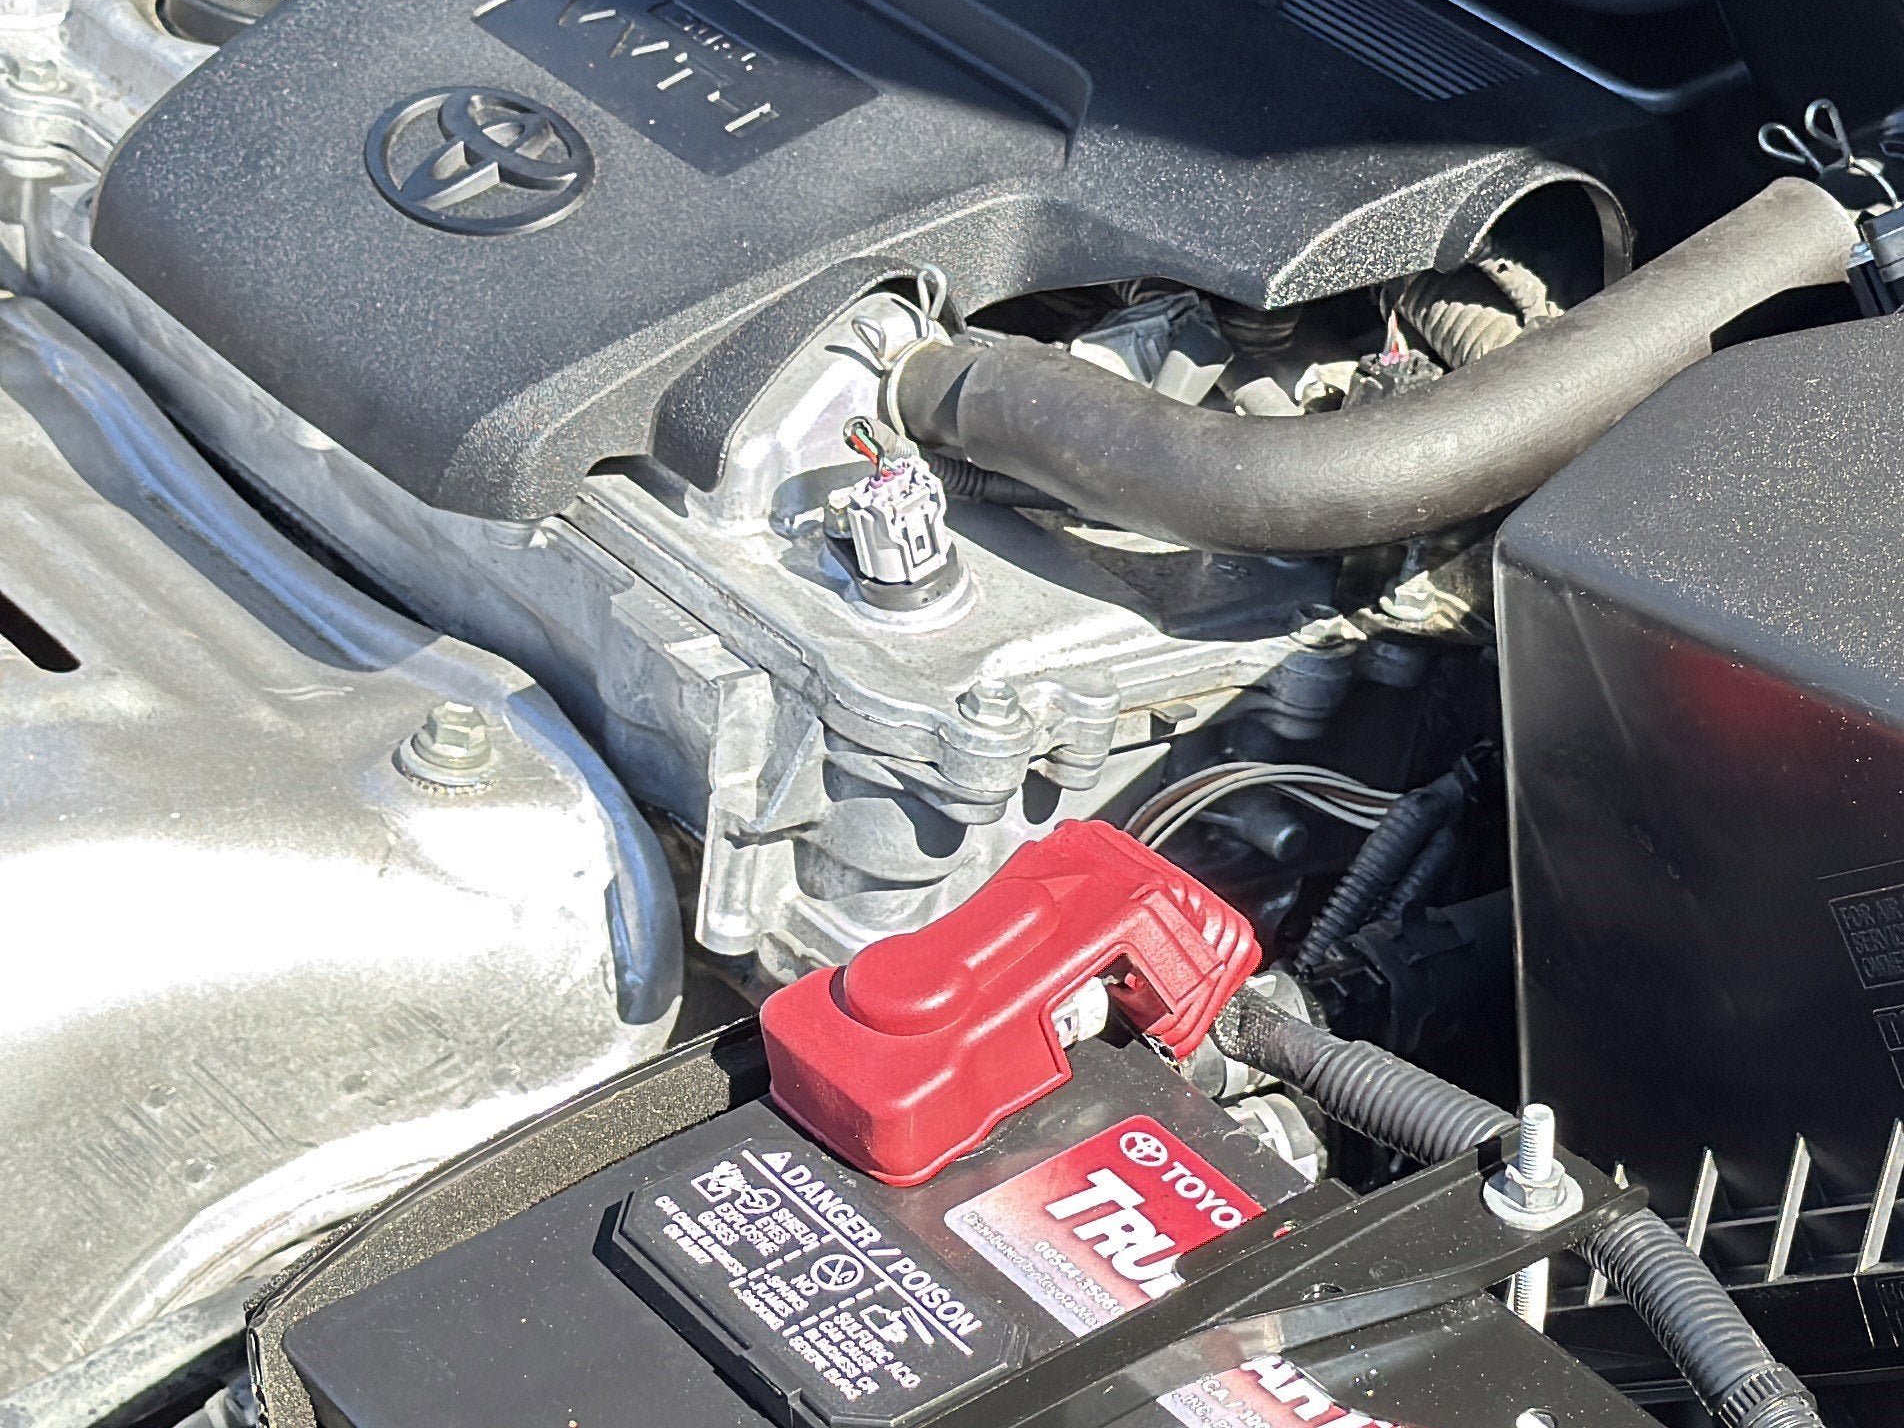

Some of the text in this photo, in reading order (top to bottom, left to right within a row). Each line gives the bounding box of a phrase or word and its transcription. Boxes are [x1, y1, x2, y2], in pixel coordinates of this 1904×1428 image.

[1839, 902, 1876, 930] FOR
[698, 1210, 740, 1246] GASES
[755, 1215, 792, 1245] EYES
[780, 1163, 983, 1336] DANGER / POISON
[790, 1273, 820, 1297] NO
